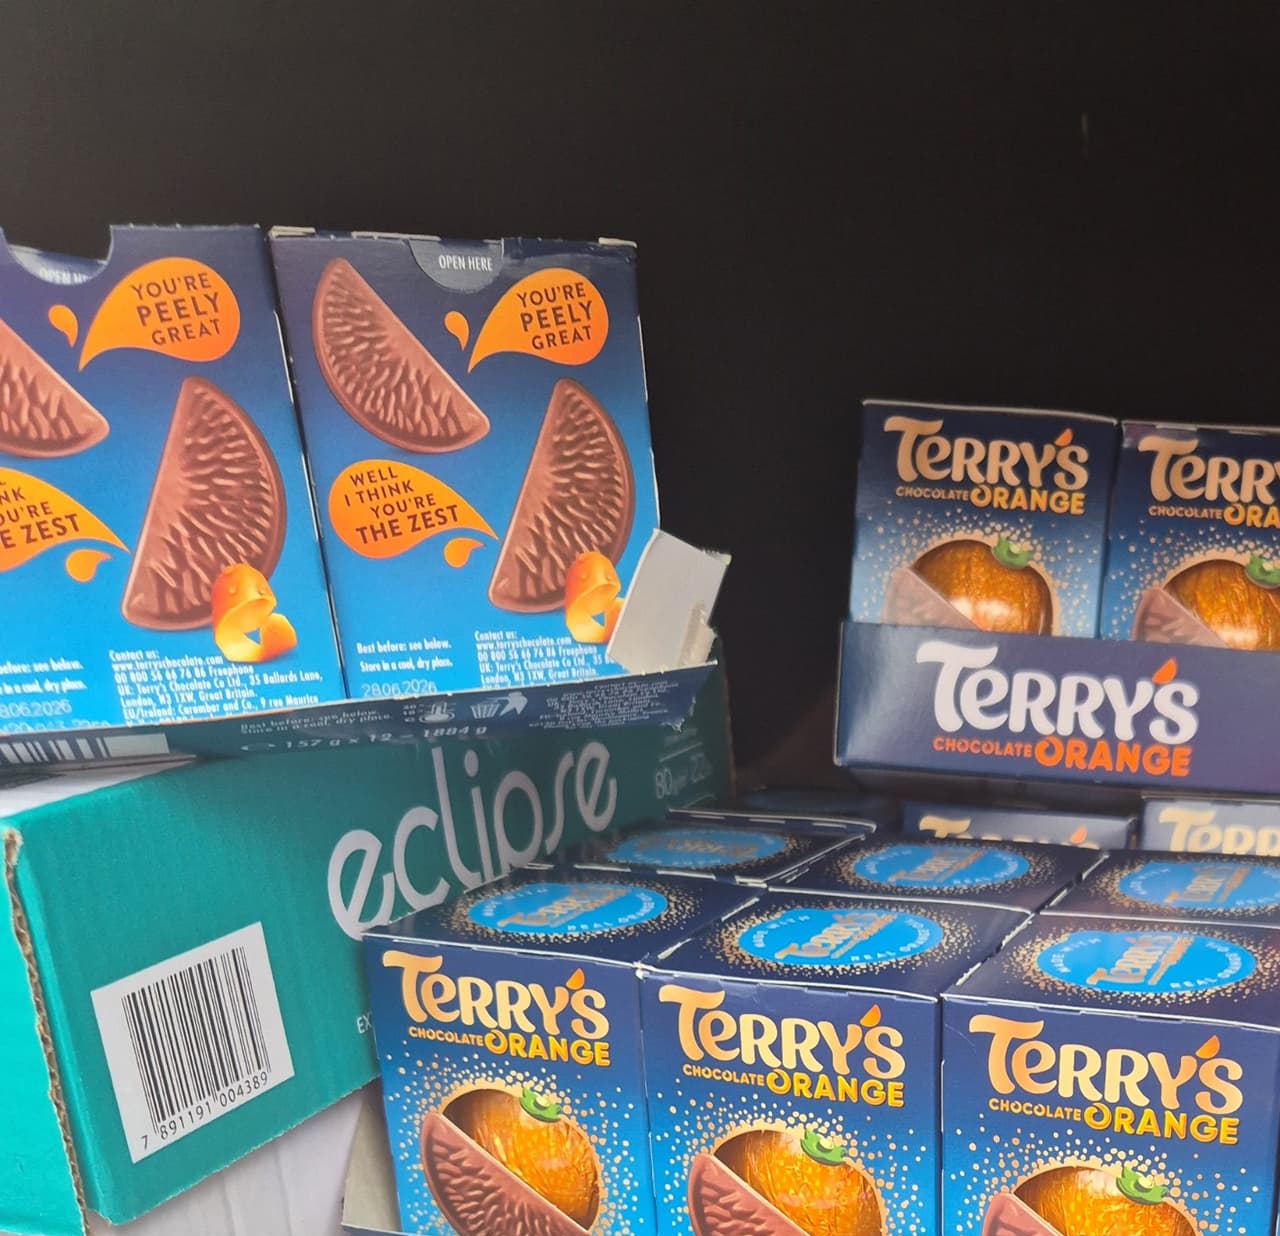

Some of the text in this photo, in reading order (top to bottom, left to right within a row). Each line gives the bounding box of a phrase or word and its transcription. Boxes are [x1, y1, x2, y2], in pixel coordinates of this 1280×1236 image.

[438, 254, 494, 272] OPEN HERE
[132, 272, 212, 301] YOU'RE
[517, 282, 587, 308] YOU'RE
[136, 293, 220, 327] PEELY
[520, 301, 593, 333] PEELY
[151, 319, 222, 346] GREAT
[531, 326, 593, 351] GREAT
[350, 467, 398, 488] WELL
[355, 480, 415, 504] THINK
[370, 493, 438, 520] YOU'RE
[970, 484, 1086, 515] ORANGE
[24, 513, 81, 540] ZEST
[356, 505, 460, 545] THE ZEST
[932, 735, 1193, 777] CHOCOLATE ORANGE
[407, 1026, 611, 1067] CHOCOLATE ORANGE
[682, 1064, 905, 1108] CHOCOLATE ORANGE
[141, 1071, 268, 1150] 7 891191 004389
[988, 1097, 1240, 1146] CHOCOLATE ORANGE
